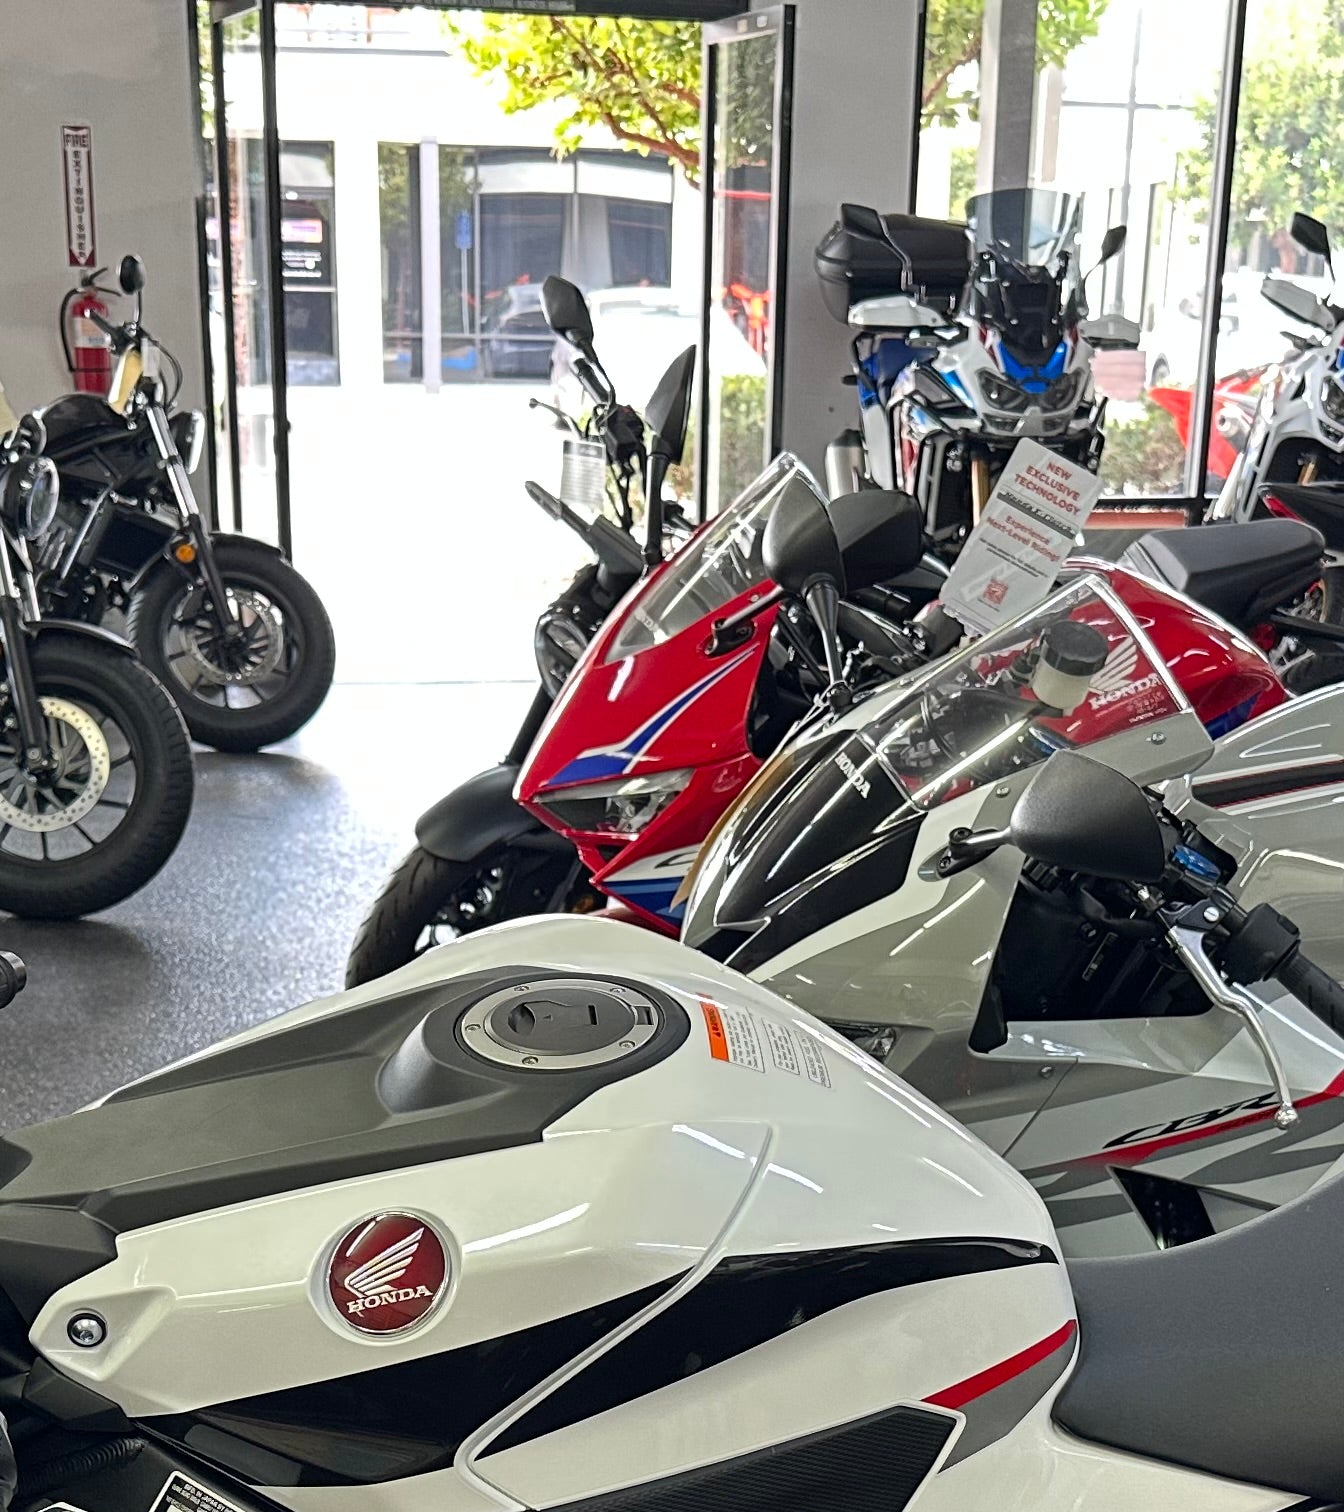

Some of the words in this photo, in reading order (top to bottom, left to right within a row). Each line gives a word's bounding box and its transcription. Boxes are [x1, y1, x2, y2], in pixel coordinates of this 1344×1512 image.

[65, 134, 88, 147] FIRE
[72, 150, 86, 258] EXTINGUISHER
[1026, 465, 1080, 501] EXCLUSIVE
[1047, 462, 1072, 481] NEW
[1015, 473, 1080, 516] TECHNOLOGY
[986, 516, 1031, 546] Next-Level
[1006, 515, 1050, 546] Experience
[1088, 673, 1163, 710] HONDA
[835, 751, 871, 798] HONDA
[1102, 1091, 1280, 1149] CBR
[346, 1285, 433, 1313] HONDA
